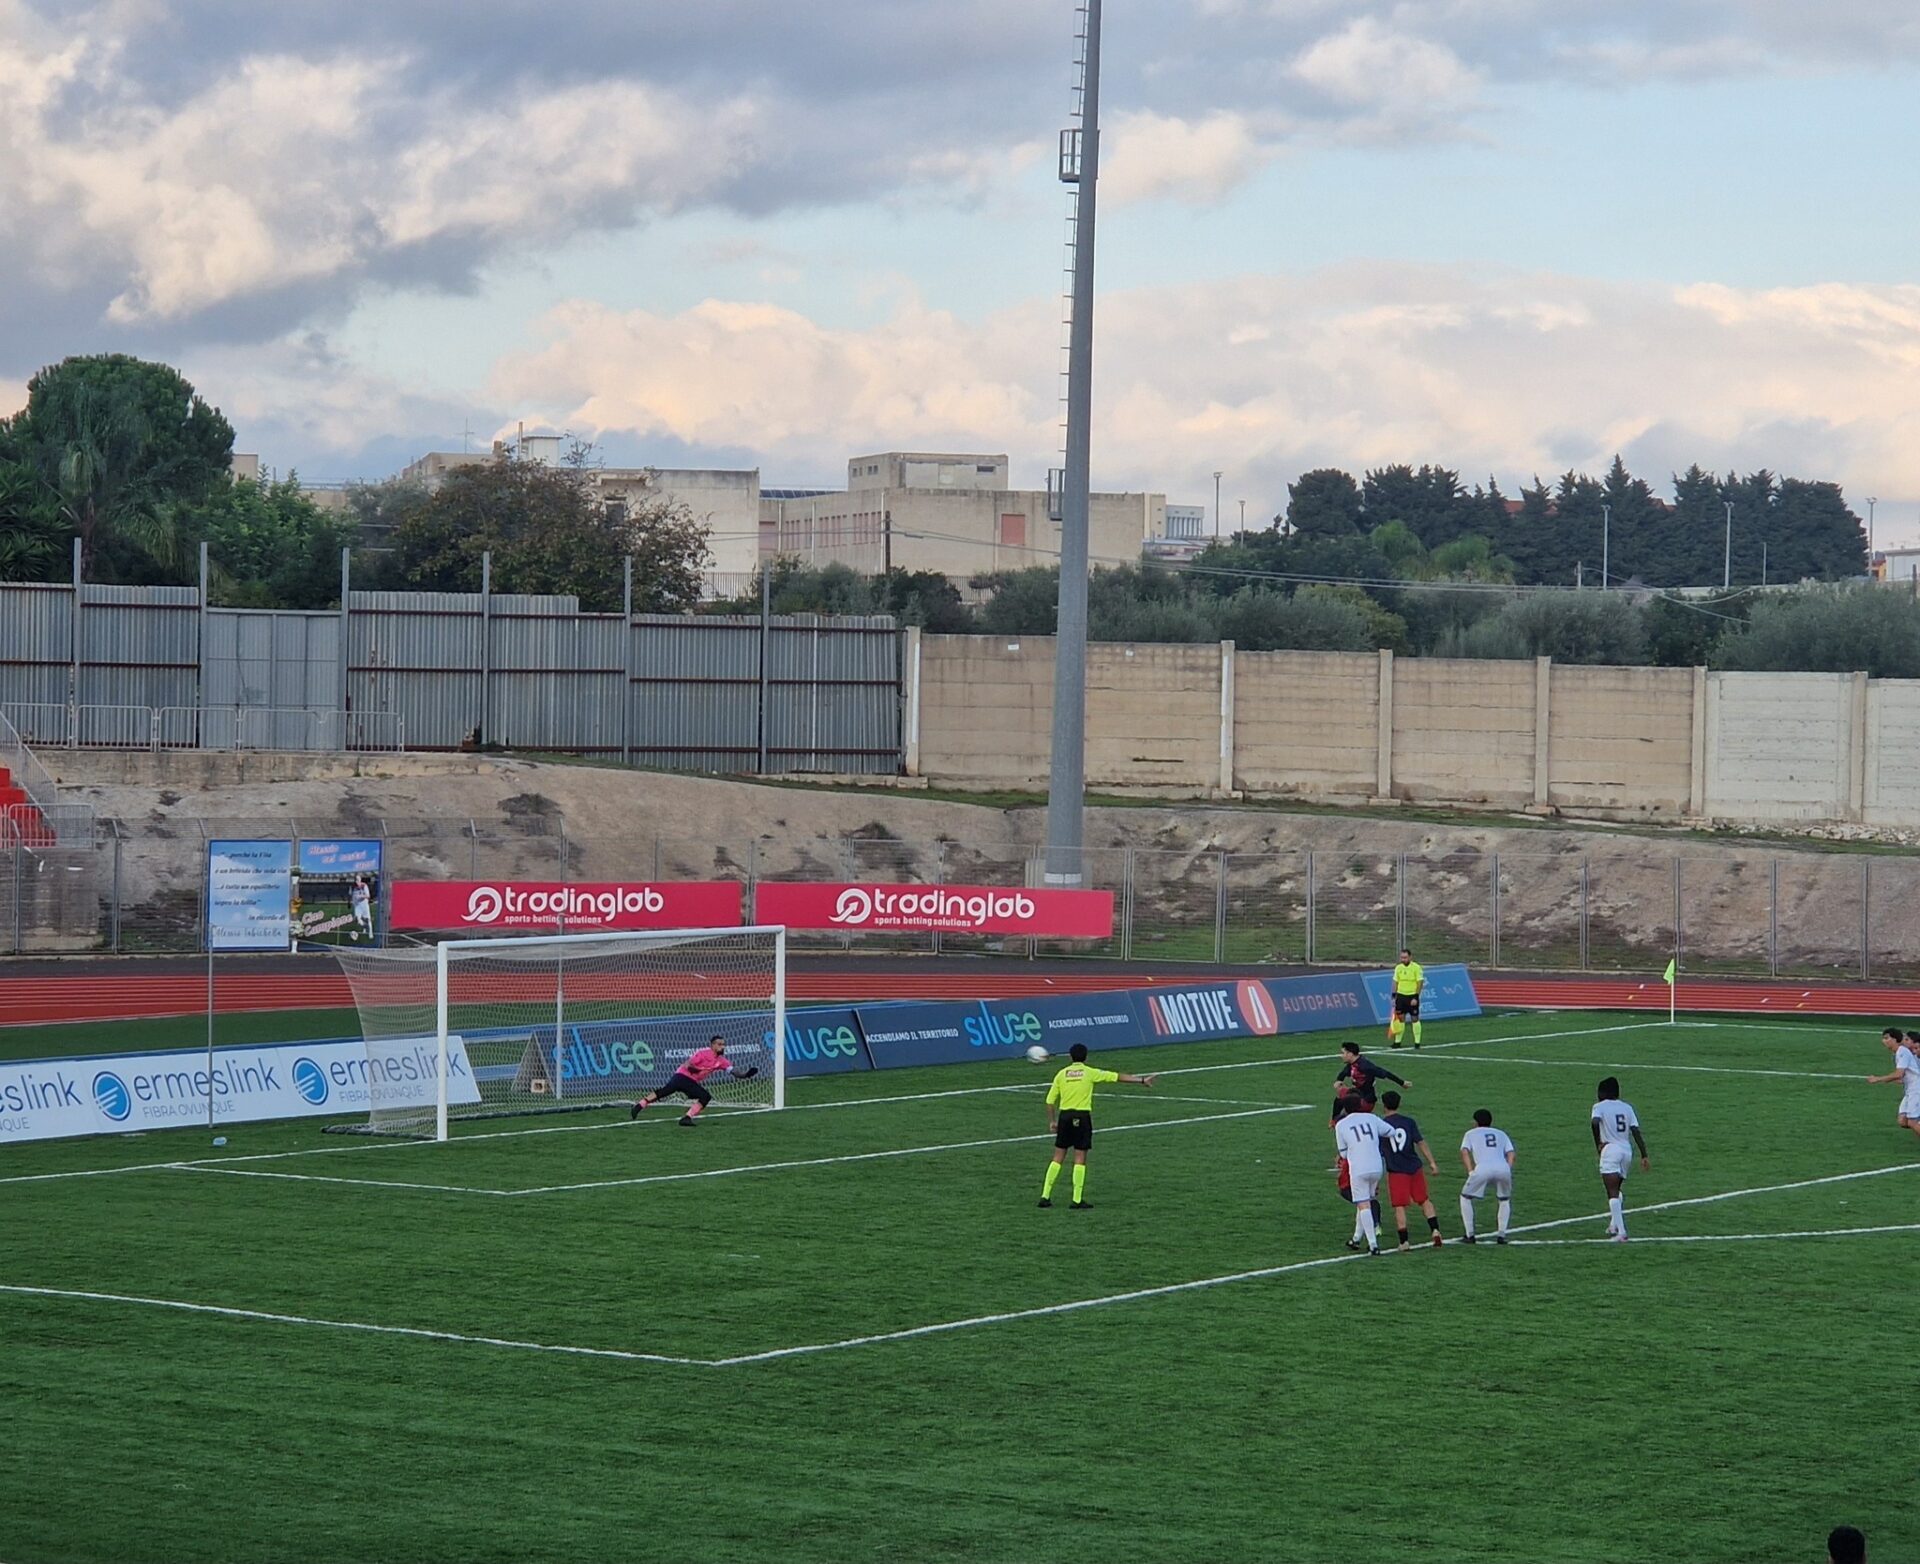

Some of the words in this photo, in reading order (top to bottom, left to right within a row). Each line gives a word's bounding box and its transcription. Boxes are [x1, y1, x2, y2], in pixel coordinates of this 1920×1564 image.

[505, 886, 664, 922] tradinglab
[874, 888, 1035, 926] tradinglab
[505, 914, 530, 924] sports
[564, 914, 602, 924] solutions
[874, 916, 900, 925] sports
[903, 916, 932, 926] betting
[933, 917, 971, 927] solutions
[1282, 992, 1359, 1013] AUTOPARTS
[866, 1032, 910, 1043] ACCENDIAMO
[919, 1029, 959, 1039] TERRITORIO
[133, 1057, 282, 1101] ermeslink
[338, 1089, 369, 1103] FIBRA
[142, 1103, 176, 1119] FIBRA
[1350, 1122, 1374, 1142] 14
[1615, 1114, 1627, 1133] 5
[1389, 1127, 1408, 1154] 19
[1485, 1133, 1498, 1148] 2
